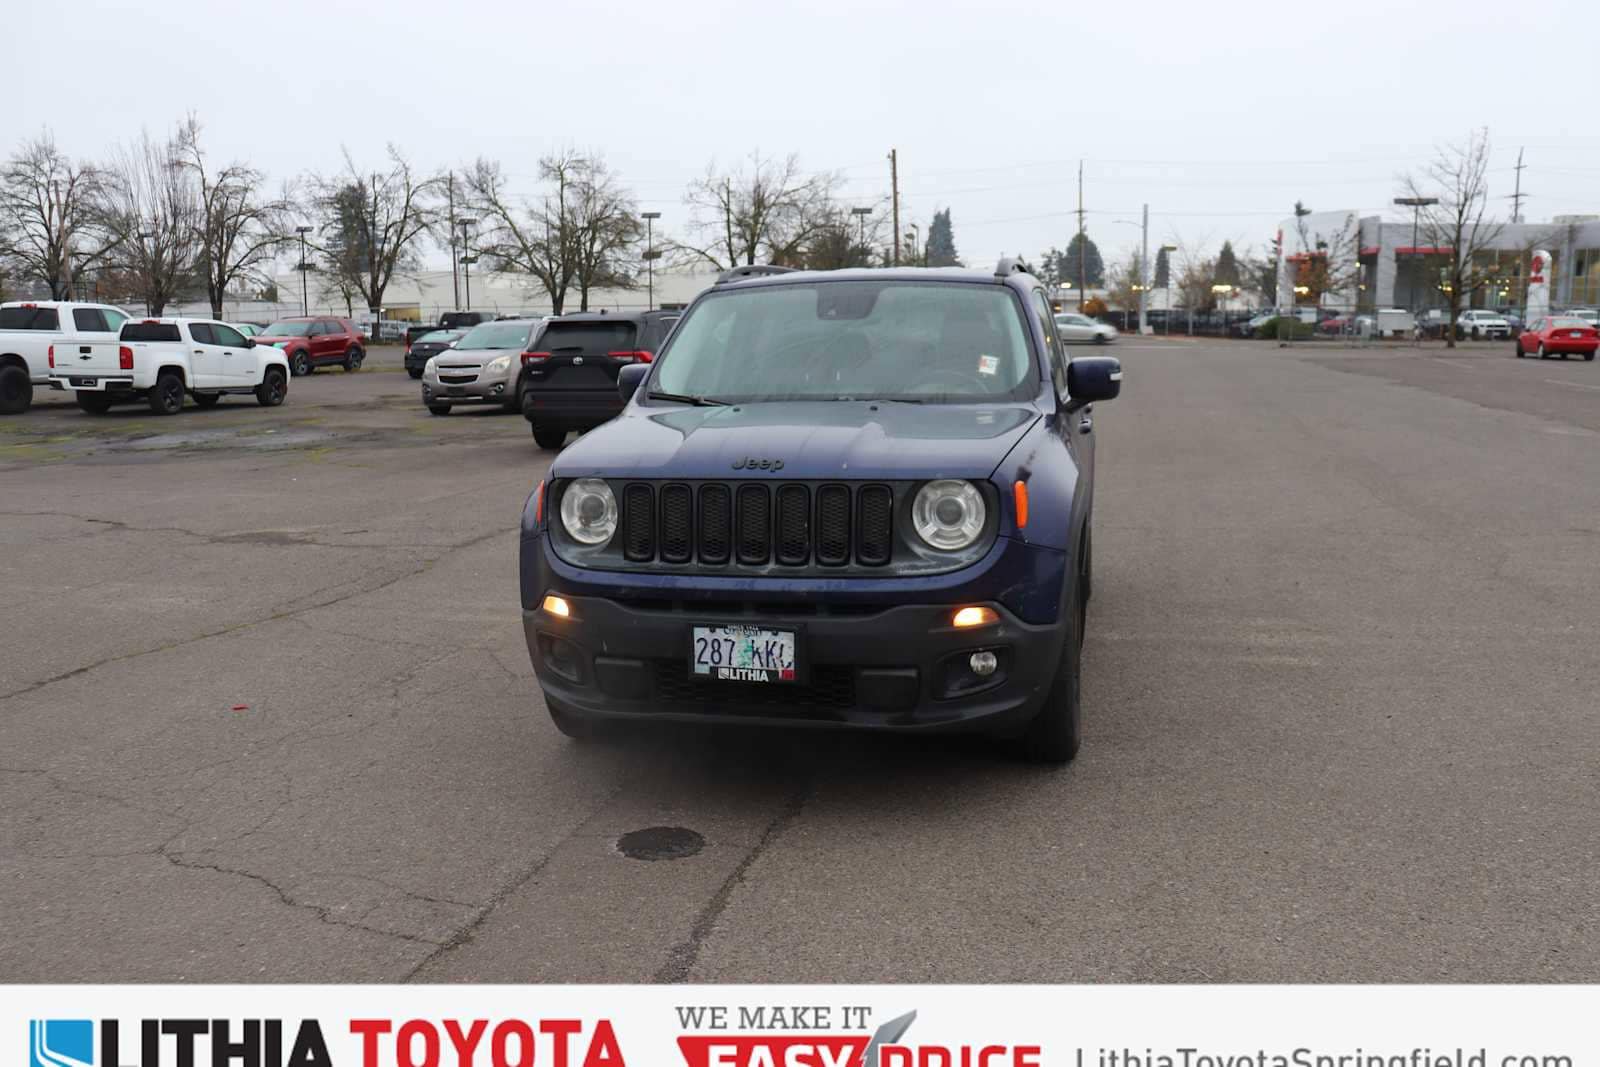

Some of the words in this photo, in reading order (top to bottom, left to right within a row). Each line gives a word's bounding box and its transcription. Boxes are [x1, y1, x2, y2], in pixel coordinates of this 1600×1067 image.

[732, 456, 785, 473] Jeep
[696, 637, 736, 666] 287
[729, 668, 769, 682] LITHIA
